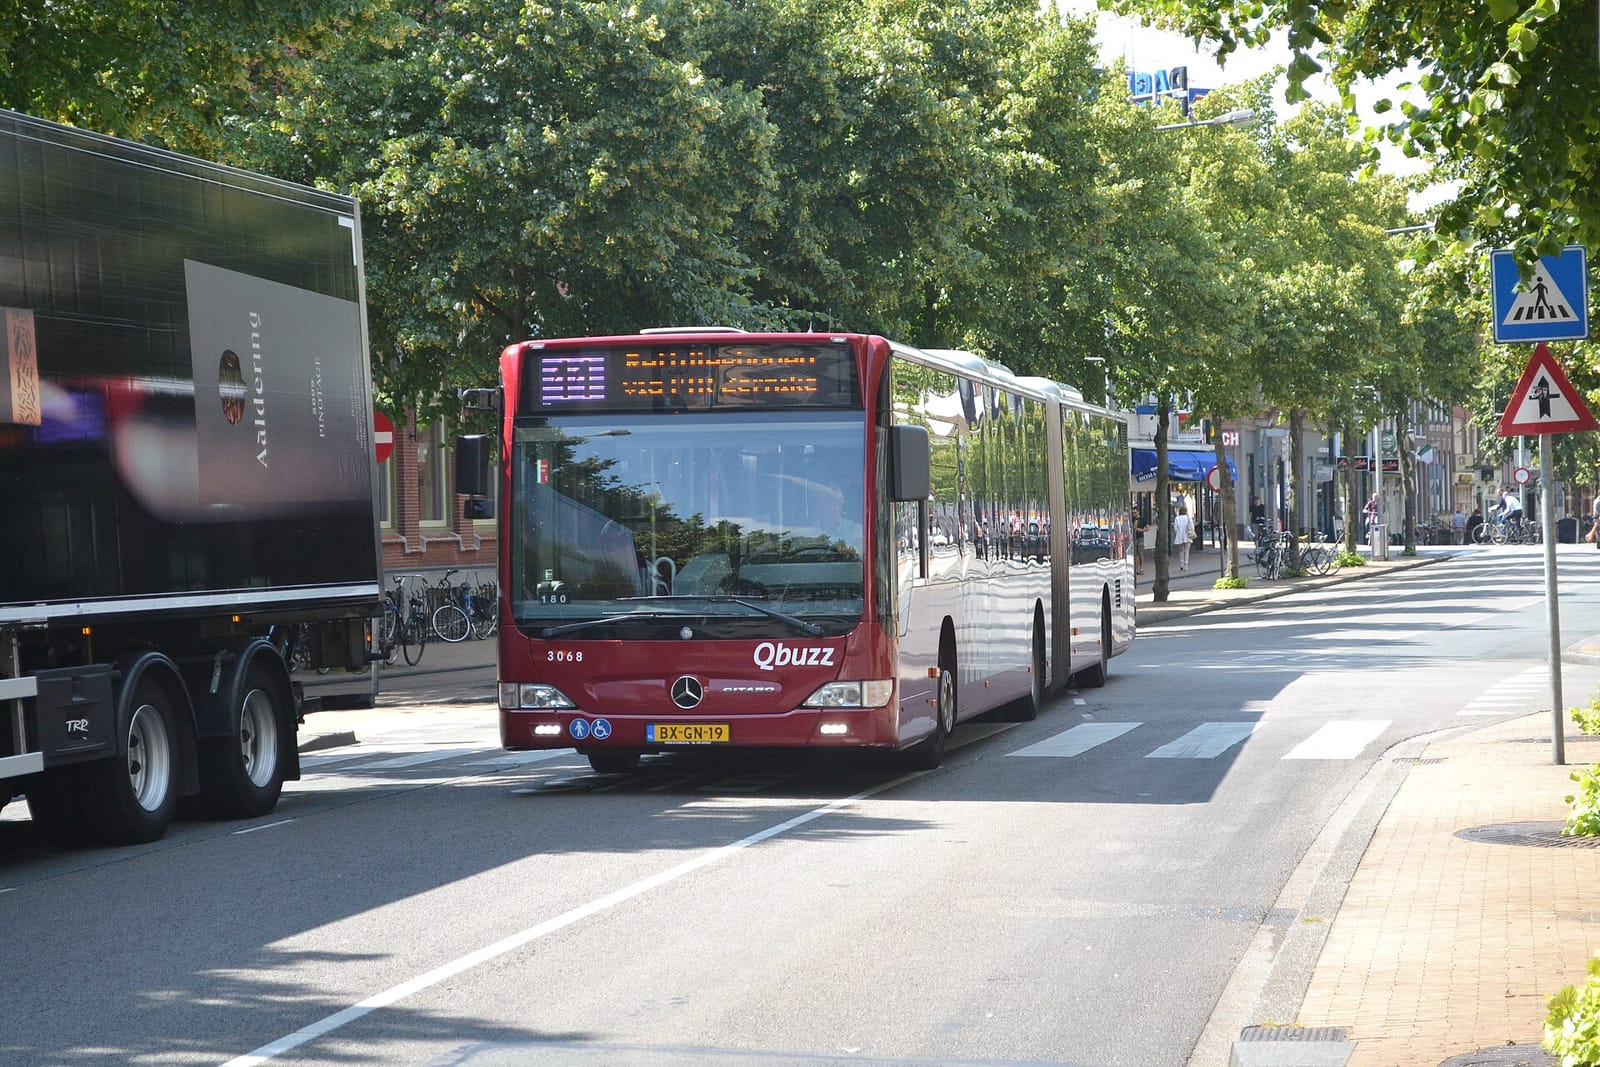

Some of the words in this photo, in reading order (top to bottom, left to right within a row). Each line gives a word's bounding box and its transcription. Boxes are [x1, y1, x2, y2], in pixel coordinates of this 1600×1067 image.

[250, 311, 268, 468] Aaldering
[313, 355, 326, 438] PINOTAGE
[541, 594, 567, 604] 180
[547, 651, 583, 662] 3068
[753, 642, 835, 671] Qbuzz
[659, 726, 724, 740] BX-GN-19
